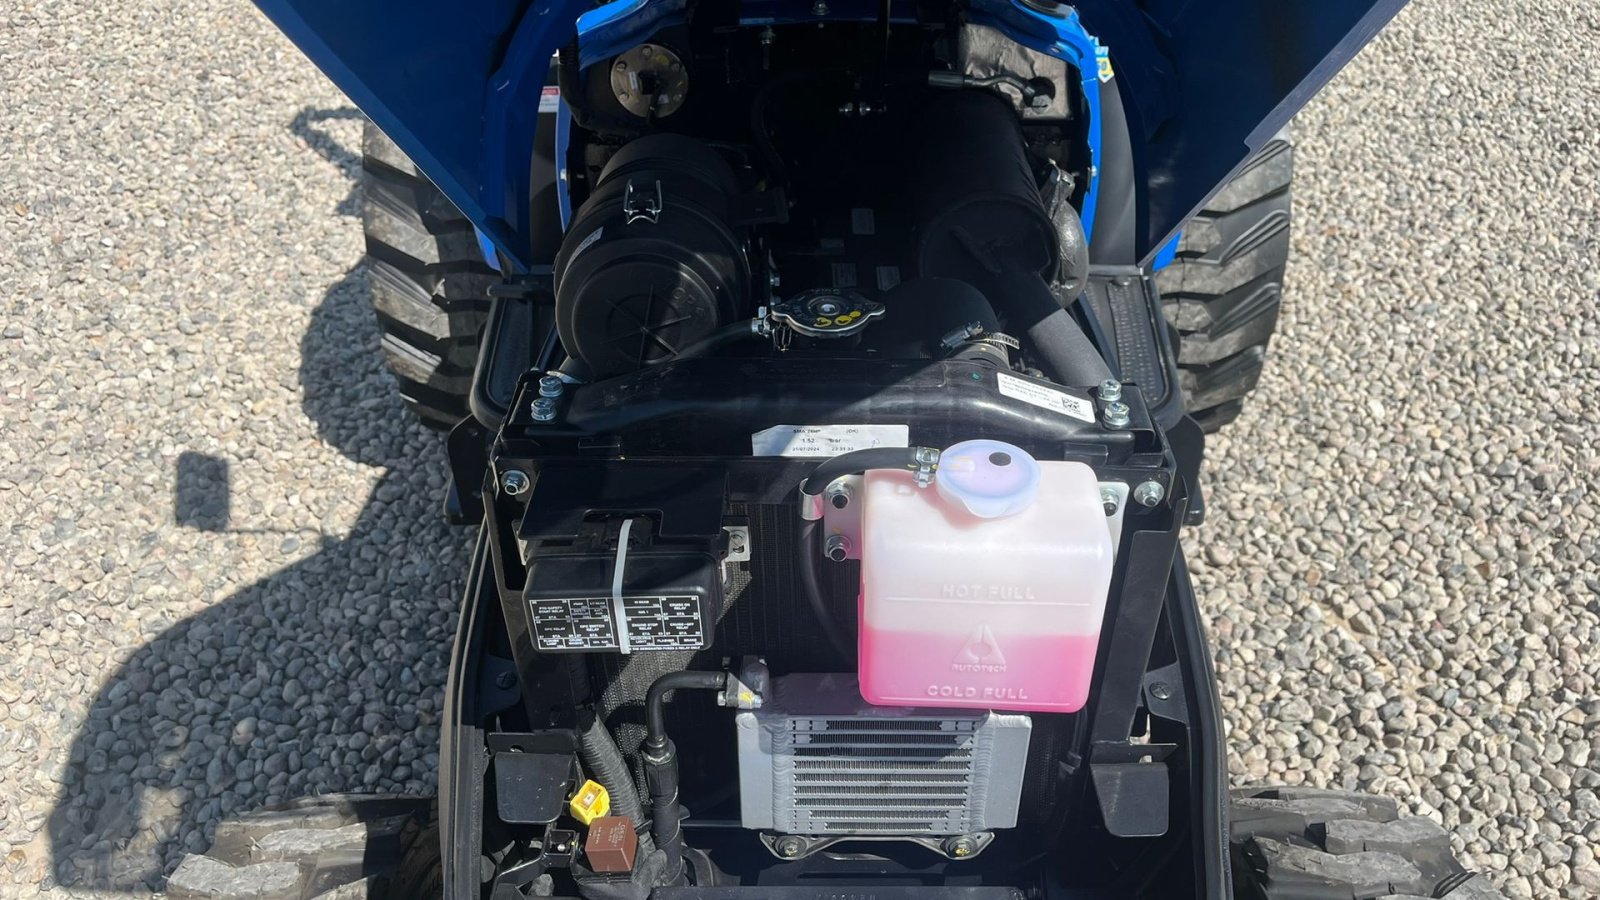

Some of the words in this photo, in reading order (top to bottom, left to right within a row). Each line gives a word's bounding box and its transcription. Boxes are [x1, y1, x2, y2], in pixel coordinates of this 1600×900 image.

[943, 583, 982, 599] HOT
[988, 584, 1035, 601] FULL
[951, 663, 1008, 673] AUTOTECH
[926, 684, 977, 698] COLD
[982, 687, 1028, 700] FULL
